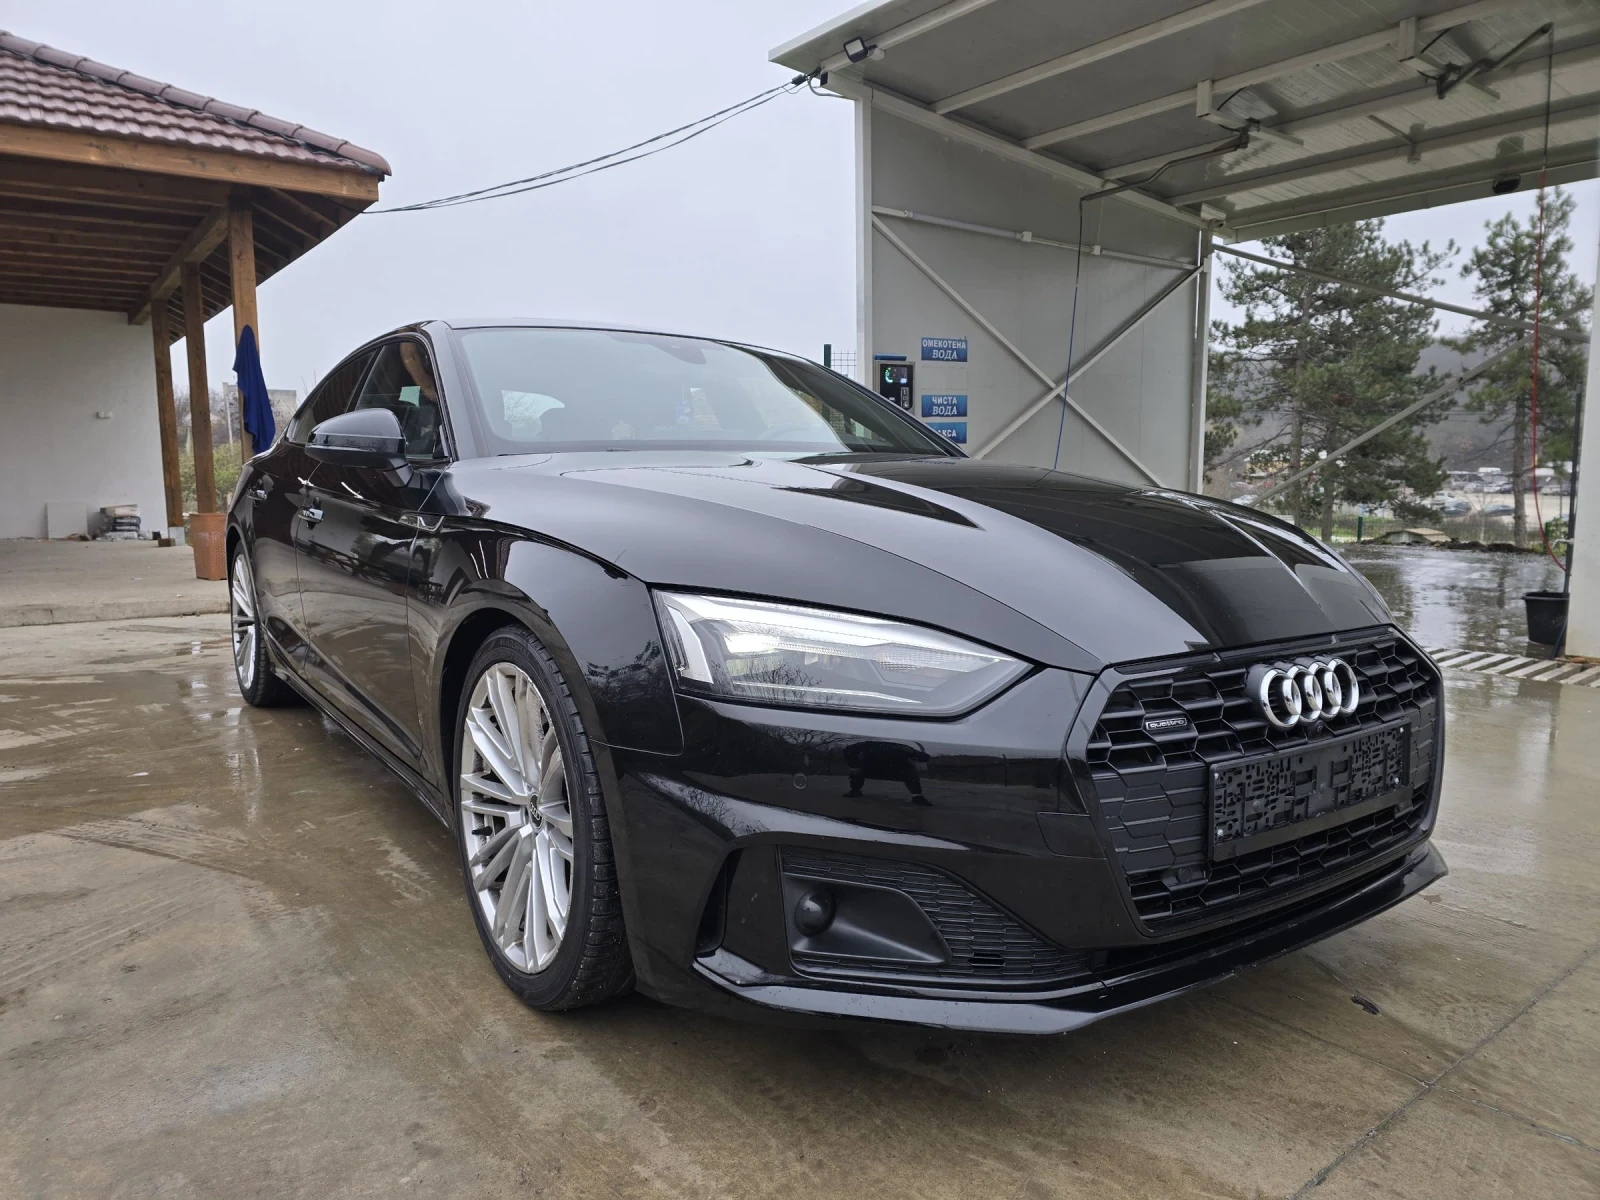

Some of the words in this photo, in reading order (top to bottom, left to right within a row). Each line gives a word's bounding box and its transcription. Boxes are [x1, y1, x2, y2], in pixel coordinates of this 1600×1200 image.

[922, 339, 966, 349] ОМЕКОТЕНА
[932, 349, 958, 360] ВОДА
[932, 396, 958, 404] ЧИСТА
[932, 406, 958, 416] ВОДА
[1149, 719, 1185, 729] quattro
